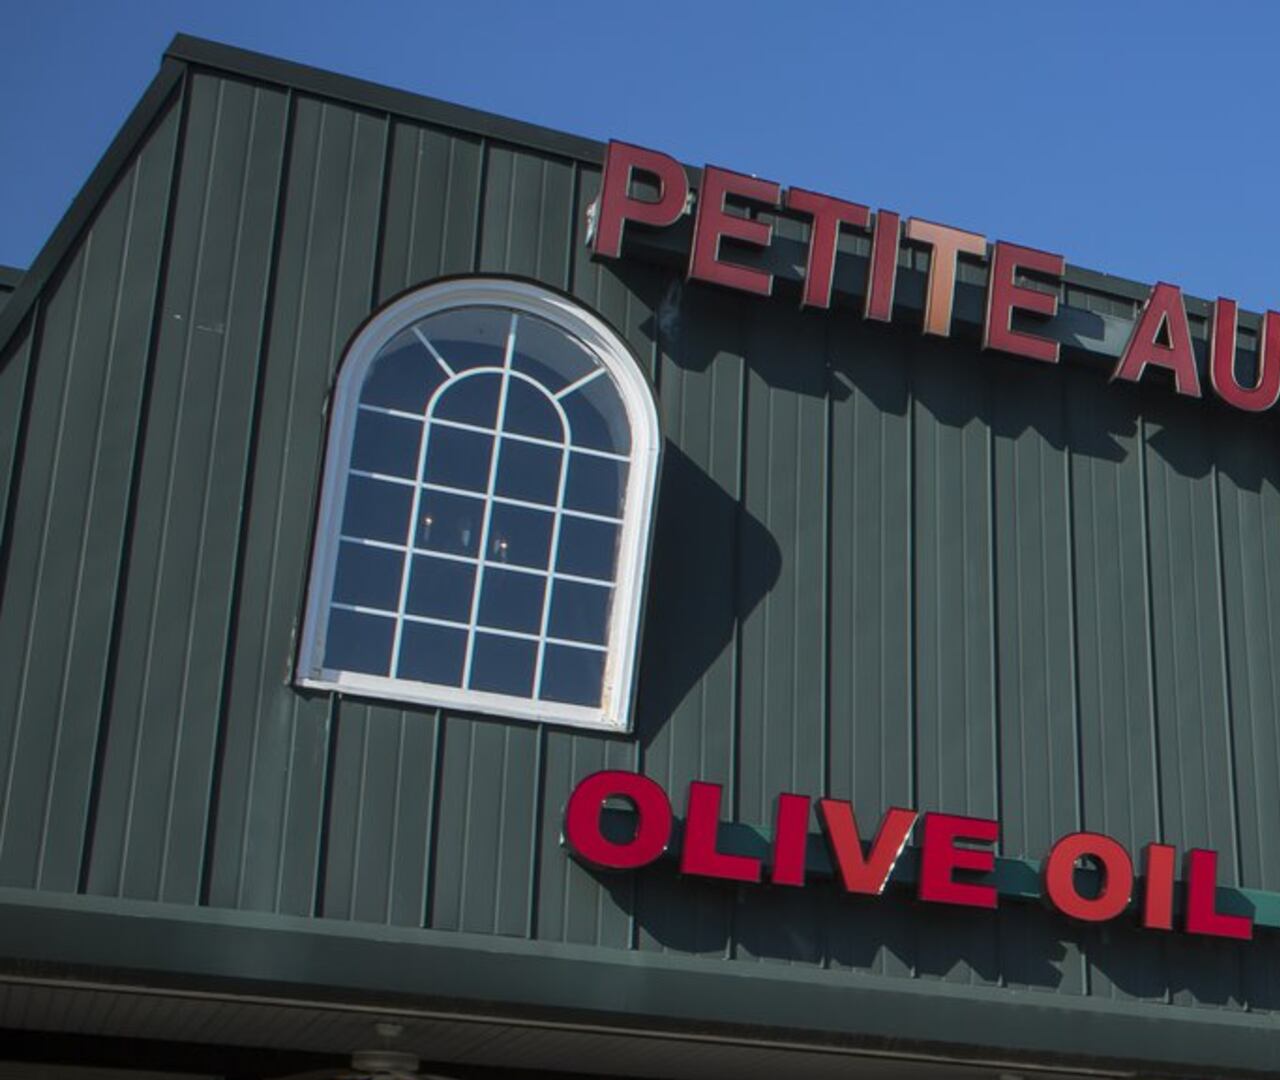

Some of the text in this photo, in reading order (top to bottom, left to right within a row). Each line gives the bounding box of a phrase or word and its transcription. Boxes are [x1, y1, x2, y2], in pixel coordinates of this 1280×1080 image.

[590, 139, 1064, 363] PETITE
[563, 769, 1000, 909] OLIVE
[1044, 831, 1253, 941] OIL
